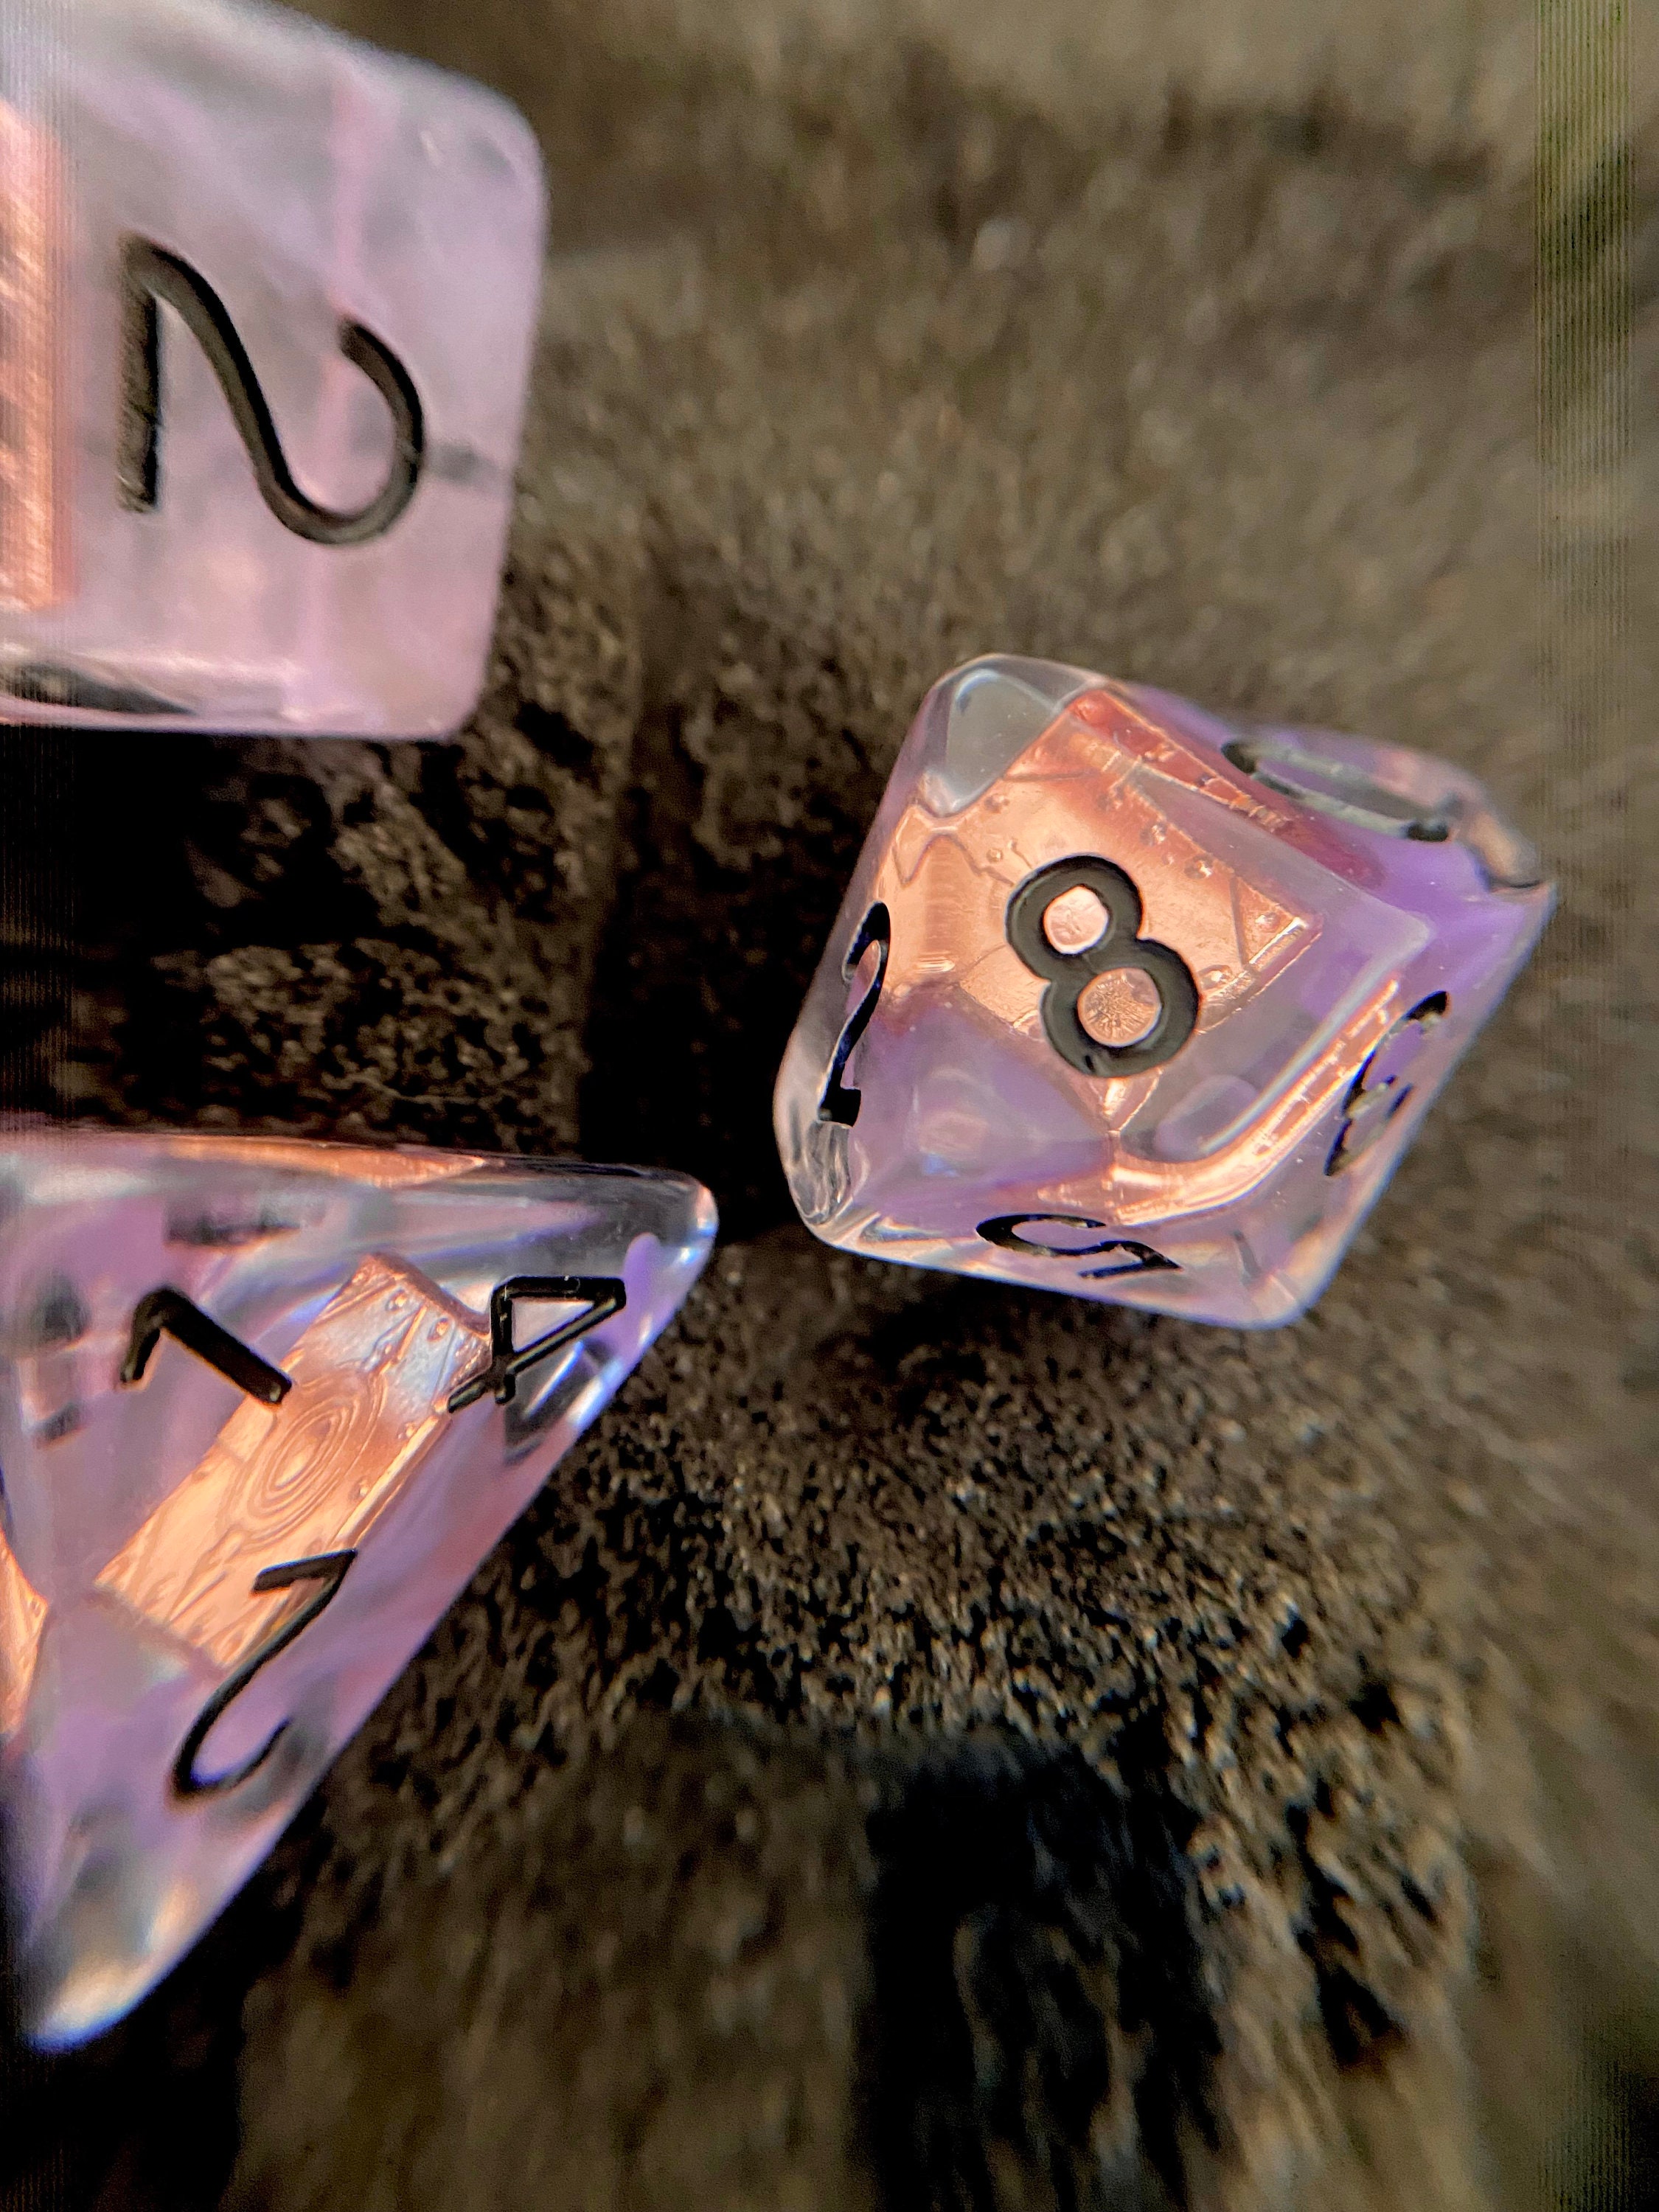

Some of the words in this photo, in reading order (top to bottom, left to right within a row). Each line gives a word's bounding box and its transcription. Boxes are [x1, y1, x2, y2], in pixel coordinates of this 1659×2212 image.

[119, 234, 425, 545] 2
[817, 901, 891, 1127] 2
[1006, 853, 1202, 1079] 8
[119, 1284, 293, 1405] 1
[447, 1274, 627, 1413] 4
[975, 1213, 1182, 1280] 5
[170, 1547, 358, 1799] 2
